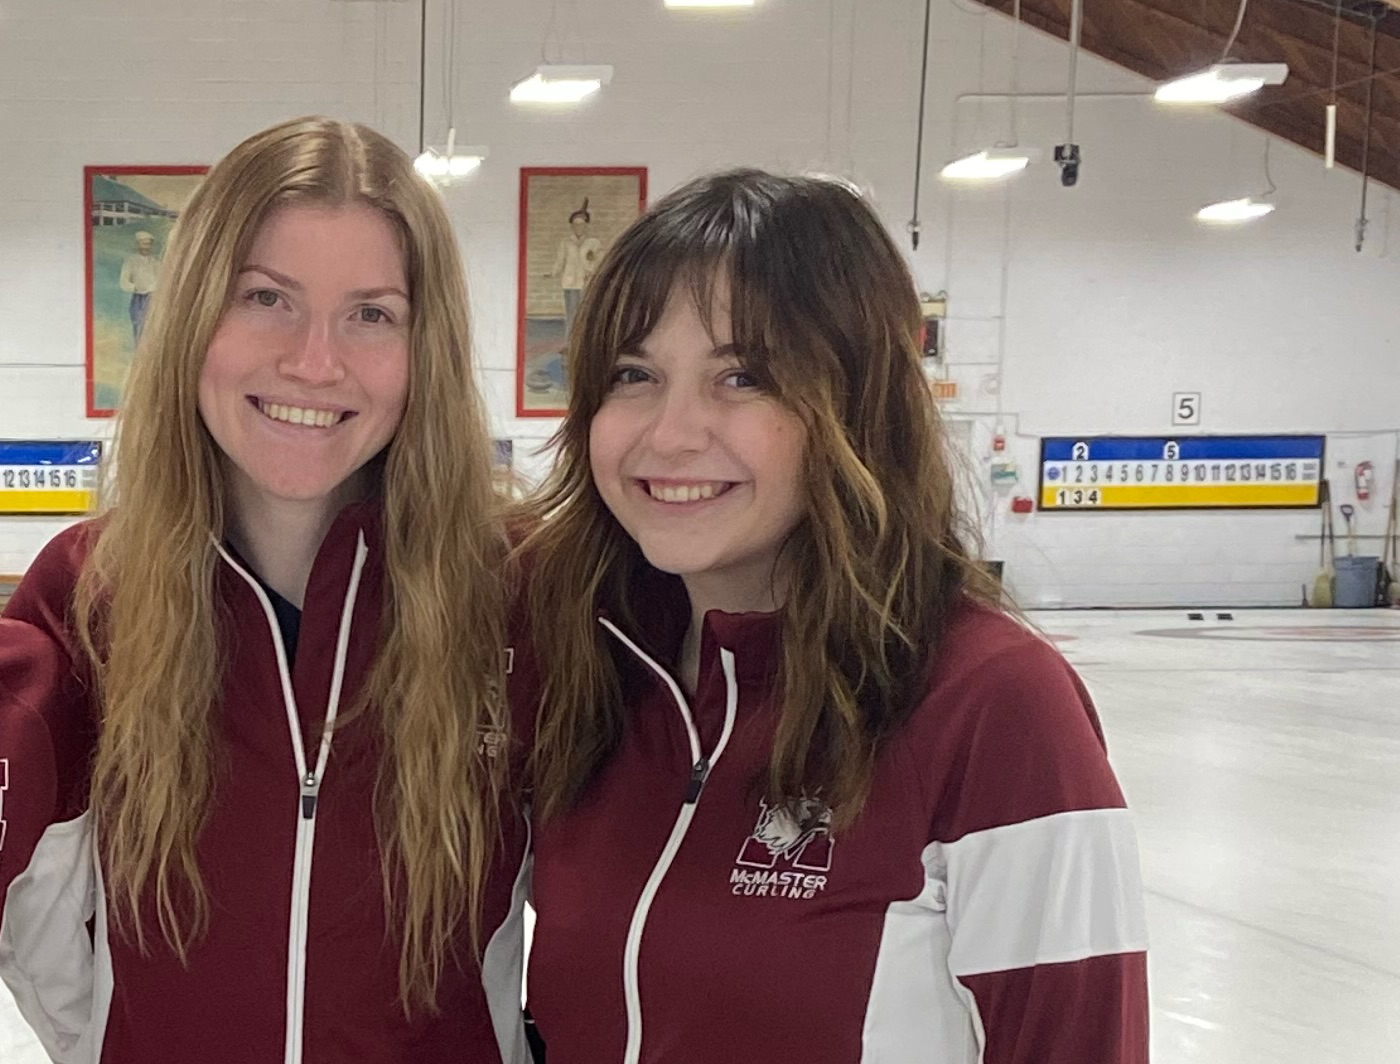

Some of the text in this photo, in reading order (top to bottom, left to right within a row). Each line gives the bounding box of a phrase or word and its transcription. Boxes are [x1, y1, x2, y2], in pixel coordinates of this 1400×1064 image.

[1179, 398, 1194, 419] 5
[1076, 445, 1176, 460] 2 5
[3, 469, 15, 487] 12
[18, 469, 31, 487] 13
[33, 469, 46, 487] 14
[49, 469, 61, 487] 15
[64, 469, 76, 487] 16
[1075, 465, 1083, 482] 2
[1090, 465, 1098, 482] 3
[1105, 465, 1113, 482] 4
[1120, 465, 1128, 482] 5
[1135, 465, 1144, 482] 6
[1151, 464, 1159, 482] 7
[1165, 464, 1174, 482] 8
[1180, 464, 1189, 482] 9
[1074, 490, 1083, 504] 3
[1088, 490, 1098, 504] 4
[730, 868, 828, 891] McMASTER
[732, 884, 816, 899] CURLING
